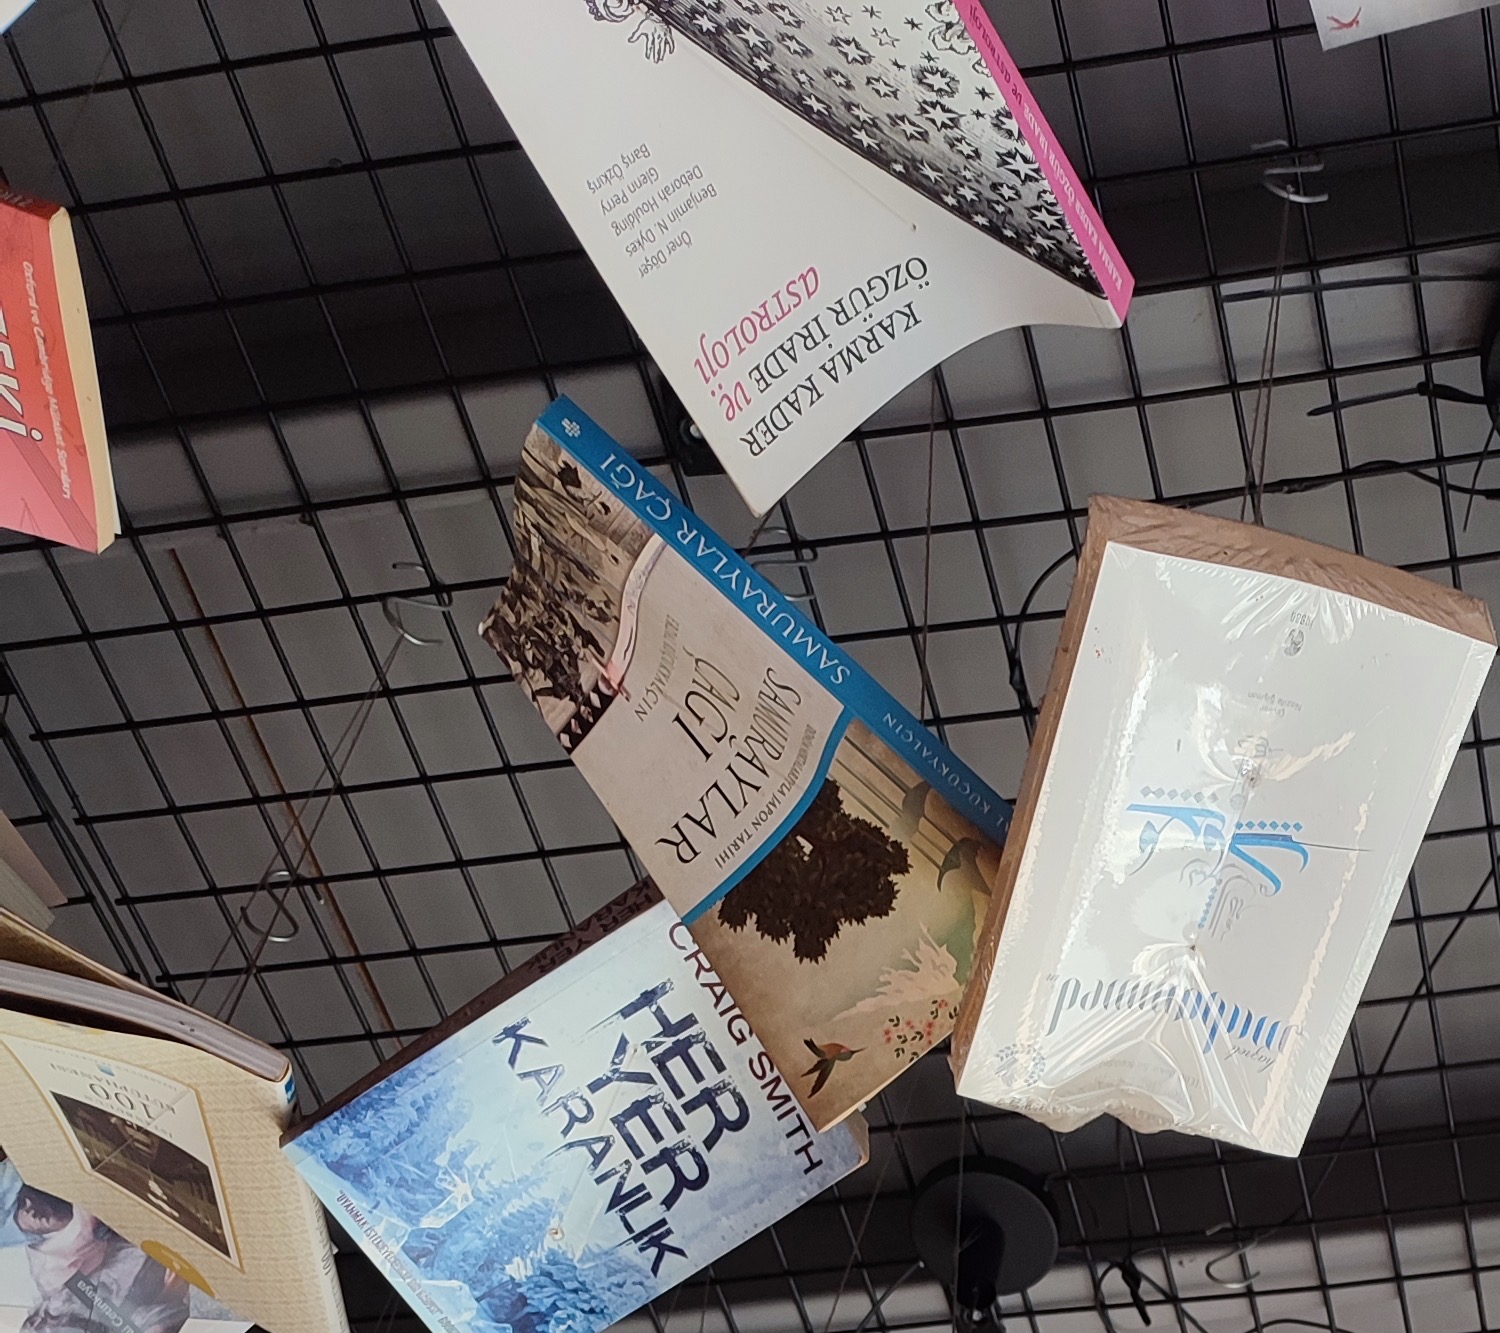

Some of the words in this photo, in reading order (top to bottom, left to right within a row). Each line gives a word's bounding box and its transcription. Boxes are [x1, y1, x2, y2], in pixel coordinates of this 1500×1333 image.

[596, 186, 630, 217] Perry
[609, 194, 661, 237] Houlding
[625, 165, 661, 196] Glenn
[656, 163, 705, 204] Deborah
[663, 179, 718, 225] Benjamin
[621, 226, 658, 259] Dykes
[652, 217, 670, 235] N.
[662, 229, 694, 259] Öner
[635, 248, 668, 279] Döşer
[825, 254, 928, 328] ÖZGÜR
[745, 314, 833, 394] İRADE
[816, 298, 922, 385] KARMA
[716, 379, 754, 423] ve
[737, 373, 826, 458] KADER
[598, 449, 677, 523] ÇAĞI
[672, 518, 853, 686] SAMURAYLAR
[672, 646, 742, 762] ÇAĞI
[654, 669, 802, 866] SAMURAYLAR
[618, 978, 759, 1158] HER
[664, 920, 756, 1049] CRAIG
[744, 1051, 827, 1177] SMITH
[492, 1015, 688, 1283] KARANLIK
[587, 1034, 716, 1217] YER
